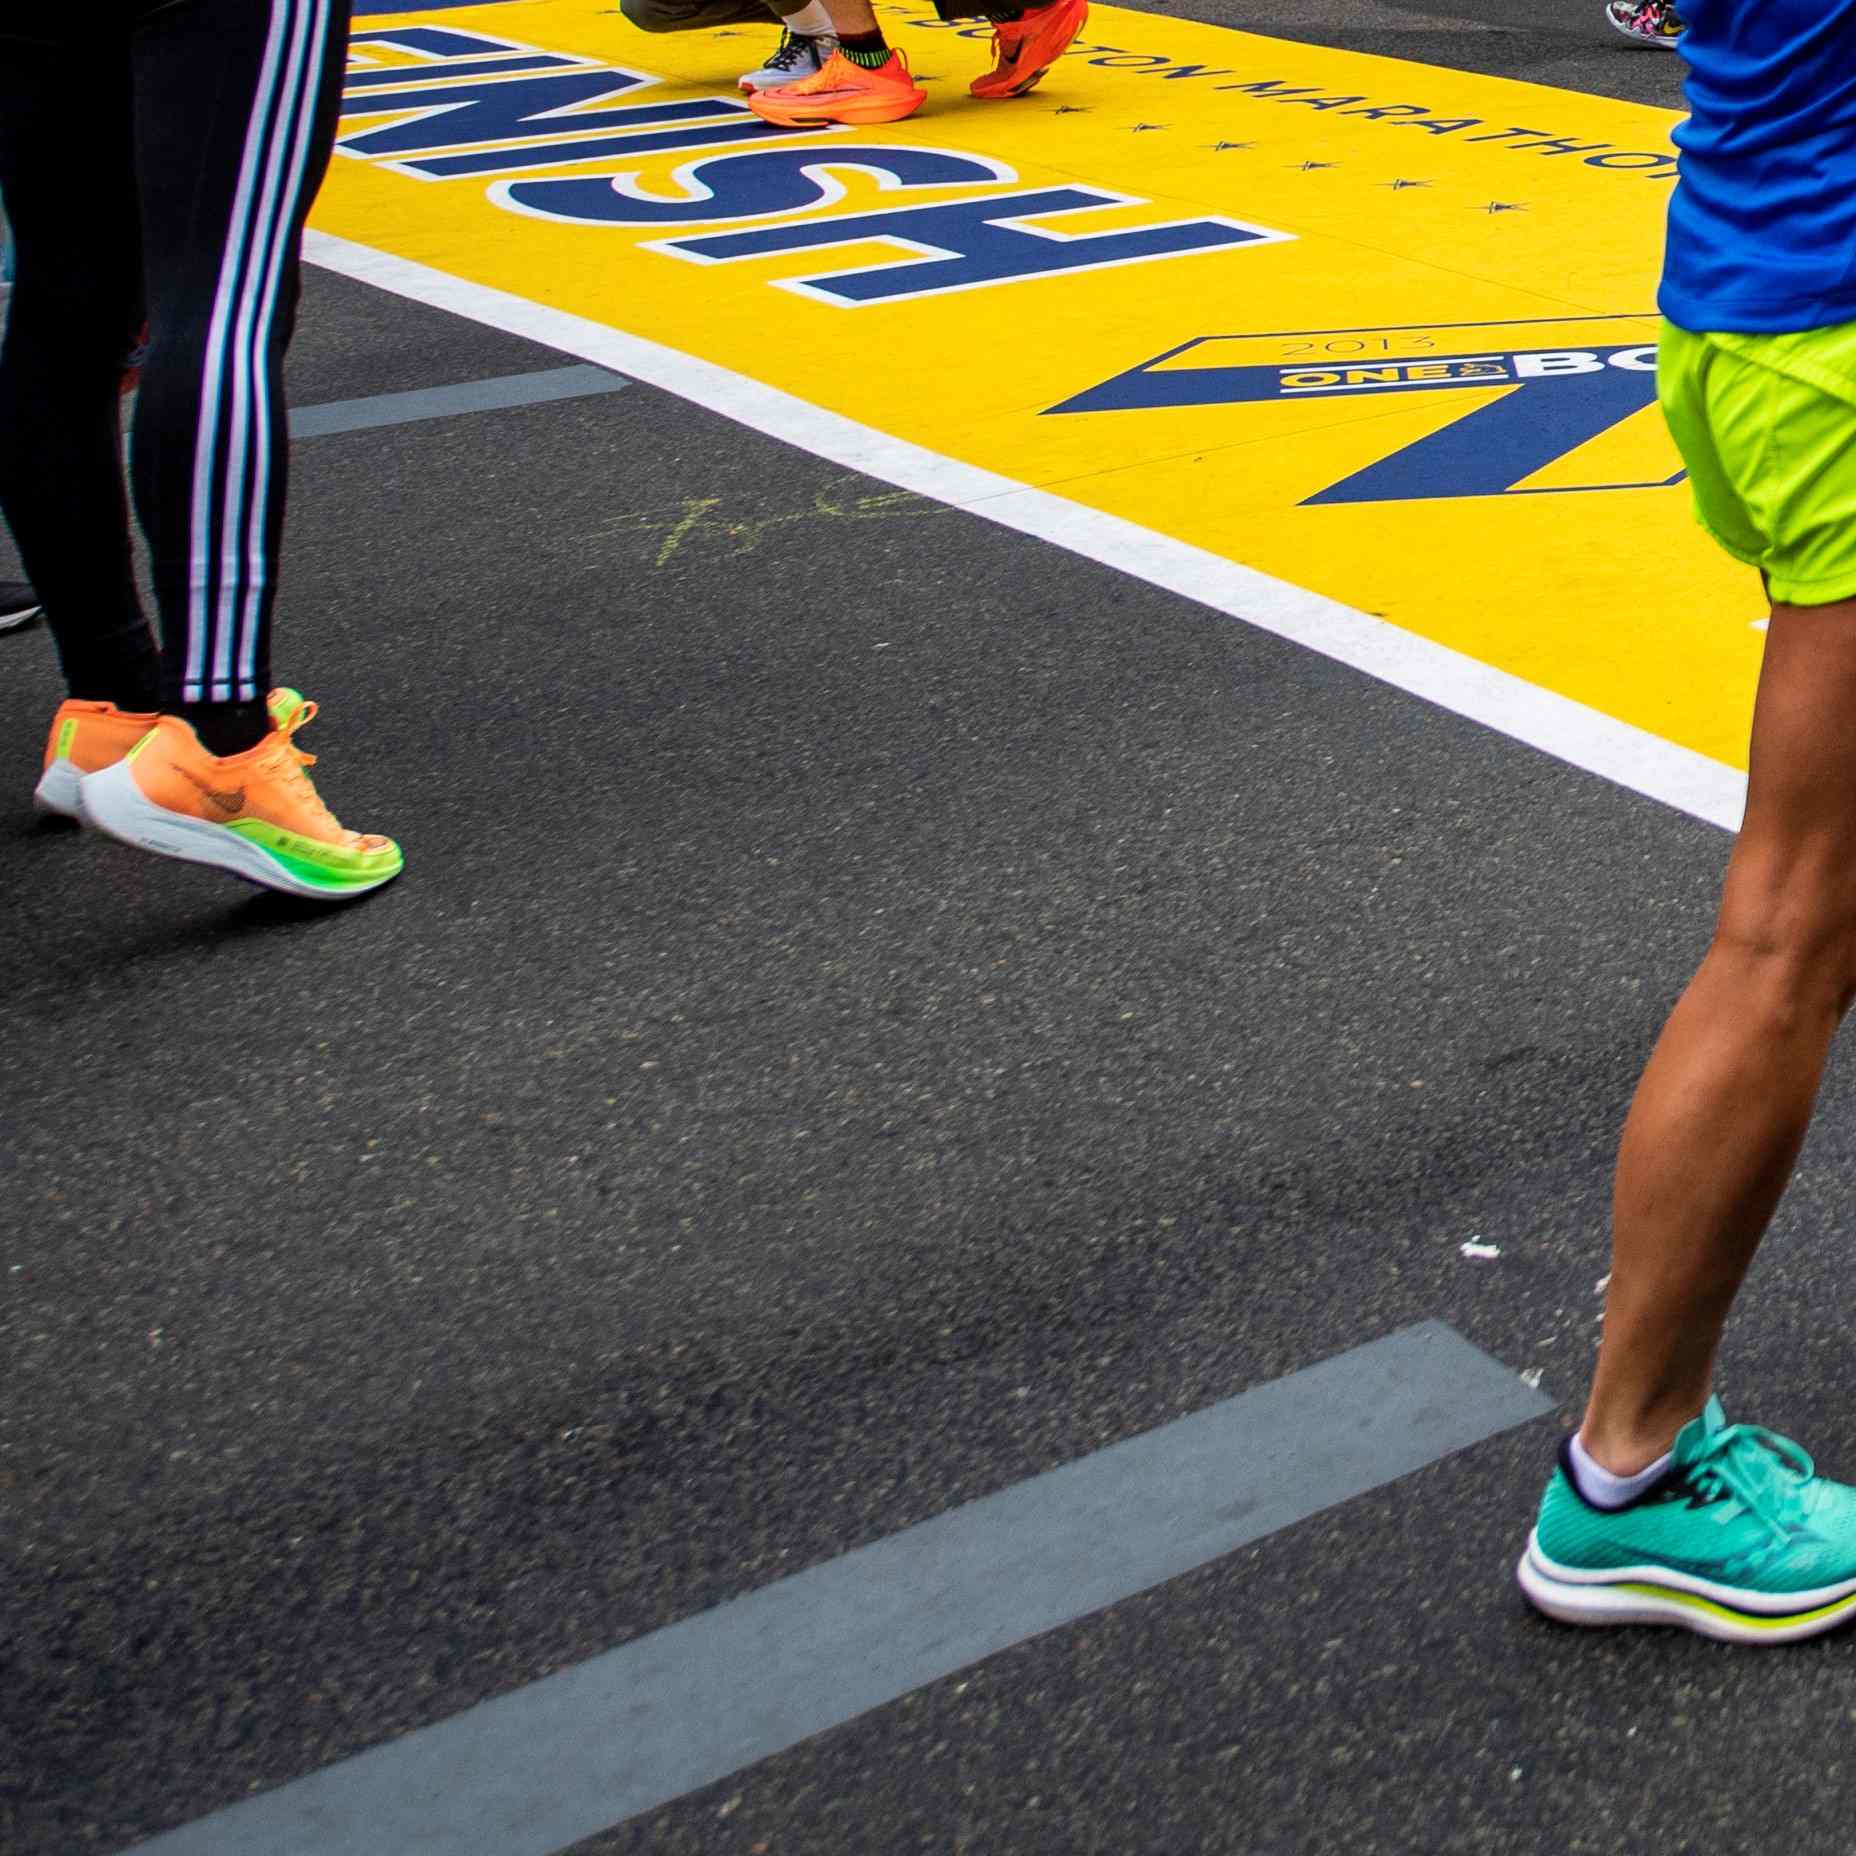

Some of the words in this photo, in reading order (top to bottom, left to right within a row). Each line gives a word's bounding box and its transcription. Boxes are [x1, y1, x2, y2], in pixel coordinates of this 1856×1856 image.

[904, 14, 1237, 80] BOTON
[1213, 78, 1680, 180] MARATHO
[1279, 334, 1438, 358] 2013
[1279, 363, 1453, 389] ONE
